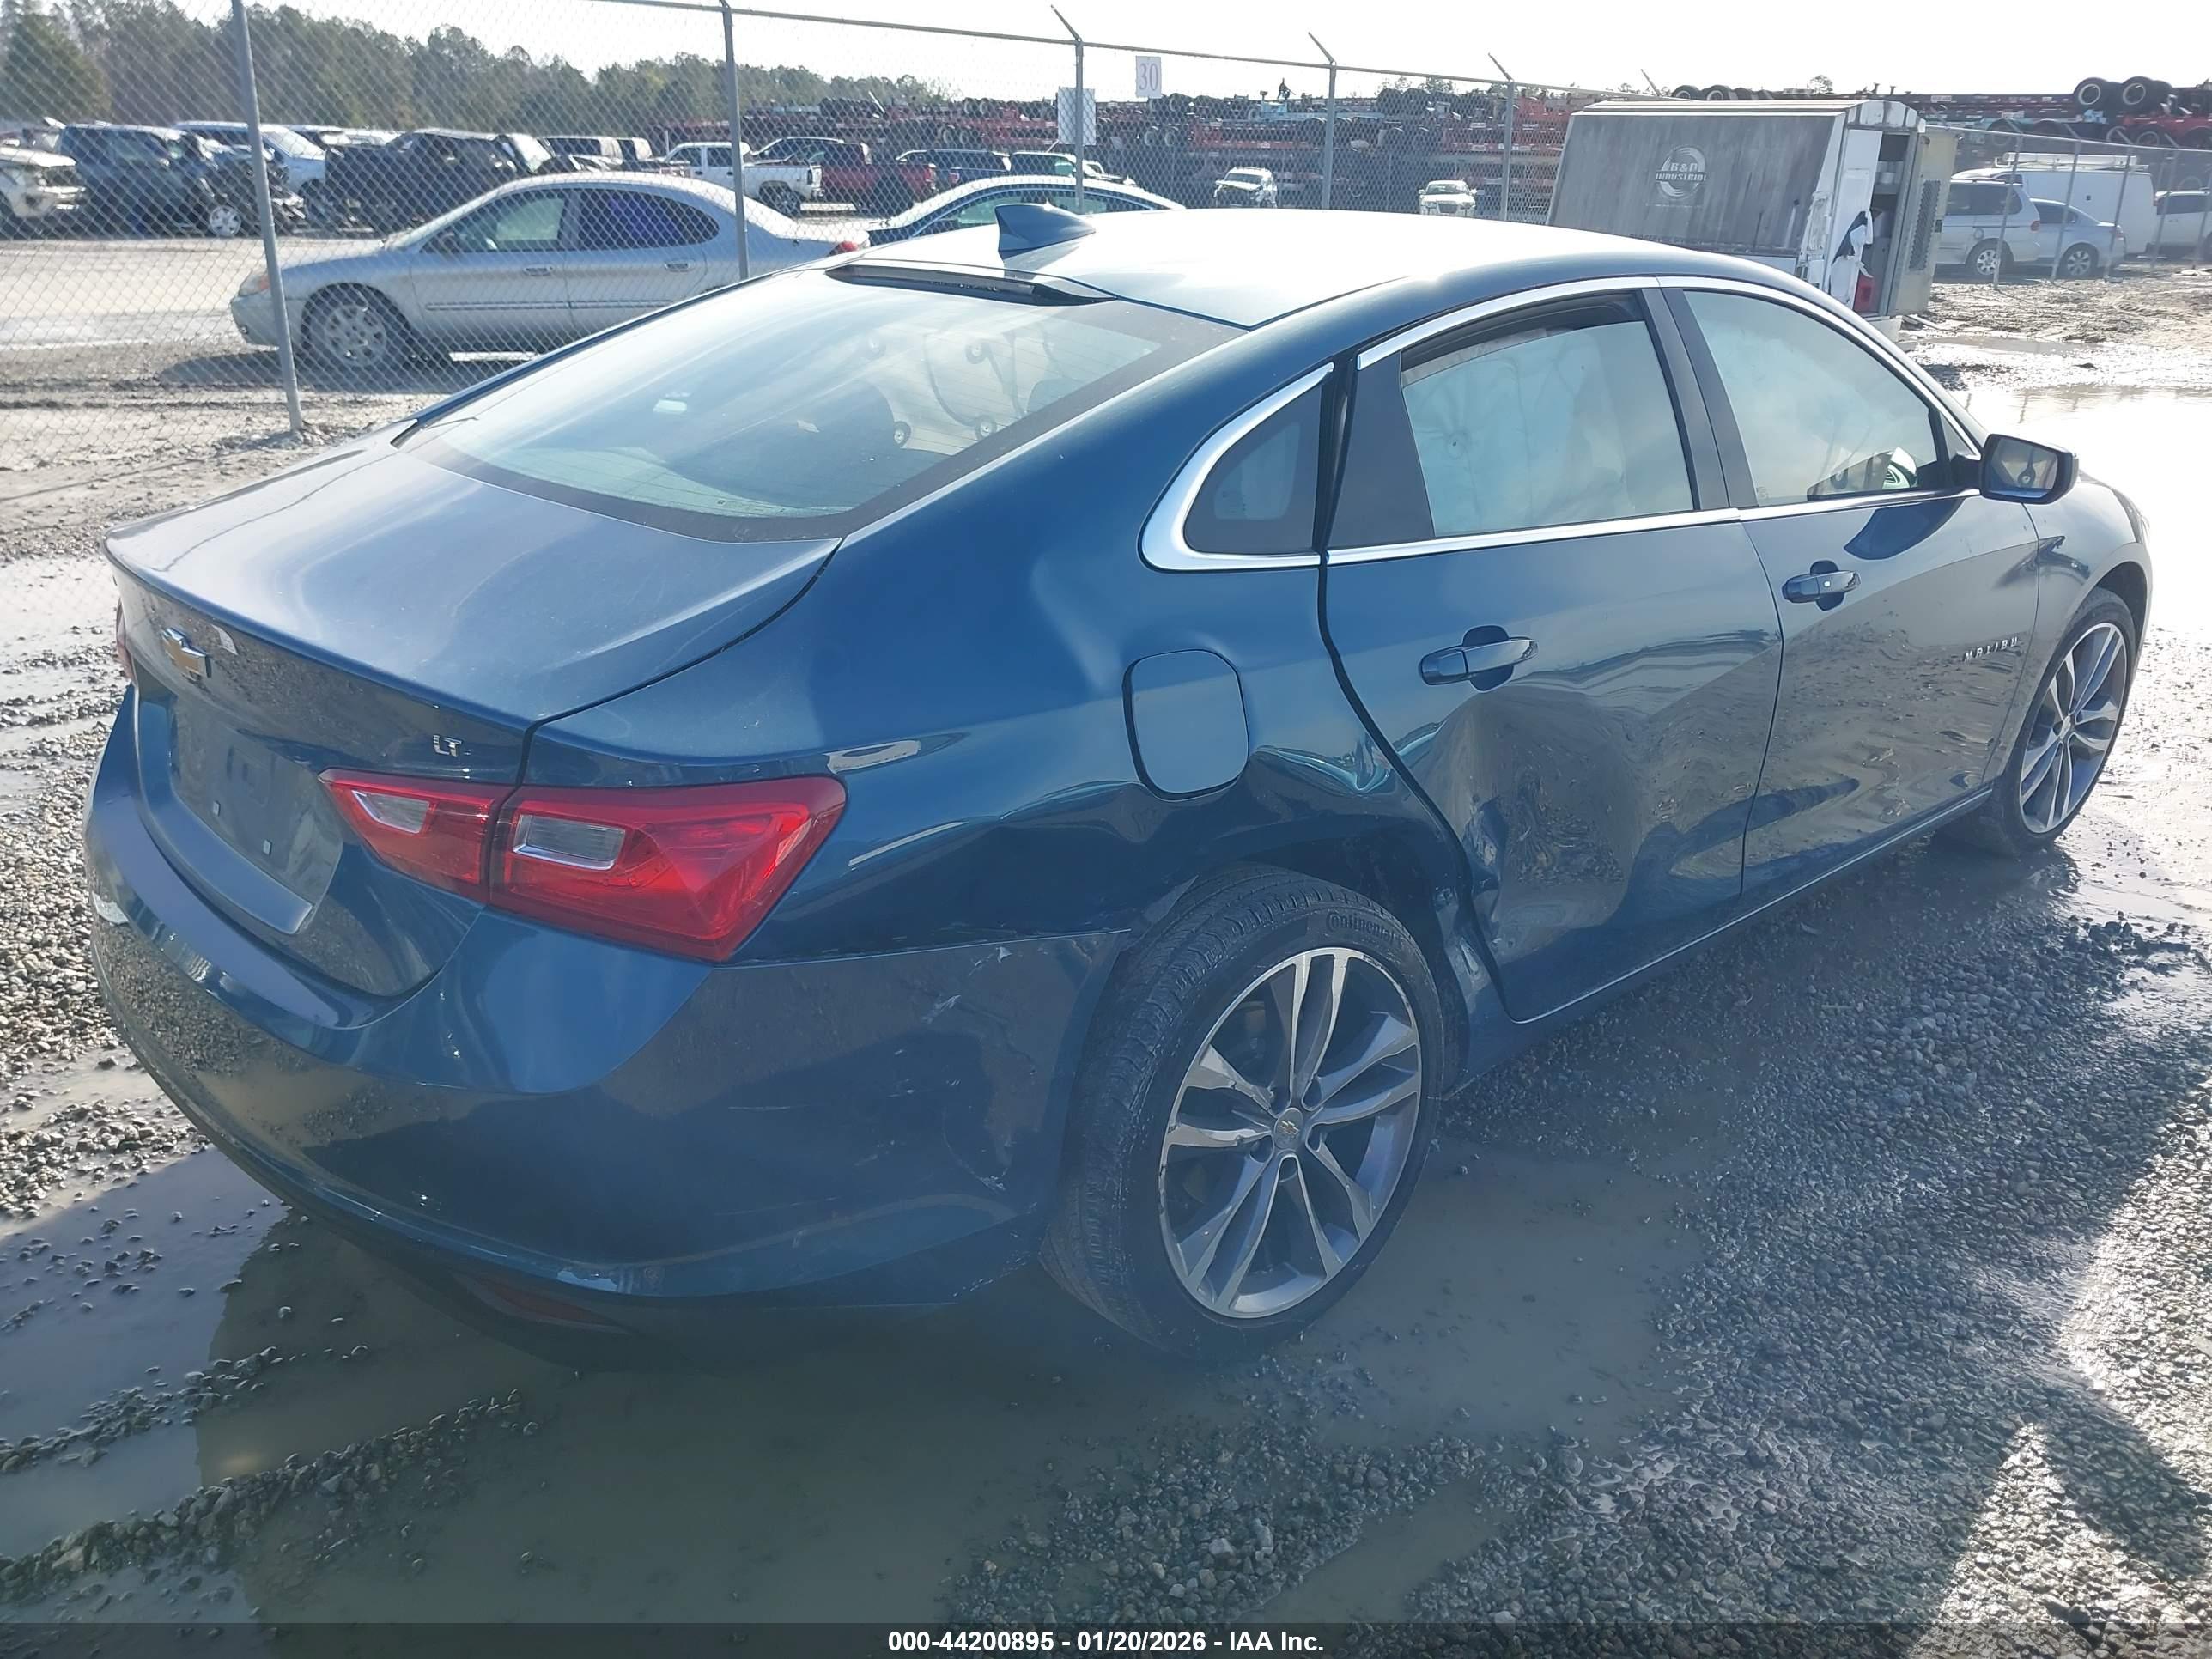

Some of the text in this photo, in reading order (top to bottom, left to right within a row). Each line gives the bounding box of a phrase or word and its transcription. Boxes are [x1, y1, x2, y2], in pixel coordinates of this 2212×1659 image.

[1139, 63, 1158, 91] 30
[1964, 636, 2018, 664] MALIBU
[433, 734, 463, 757] LT
